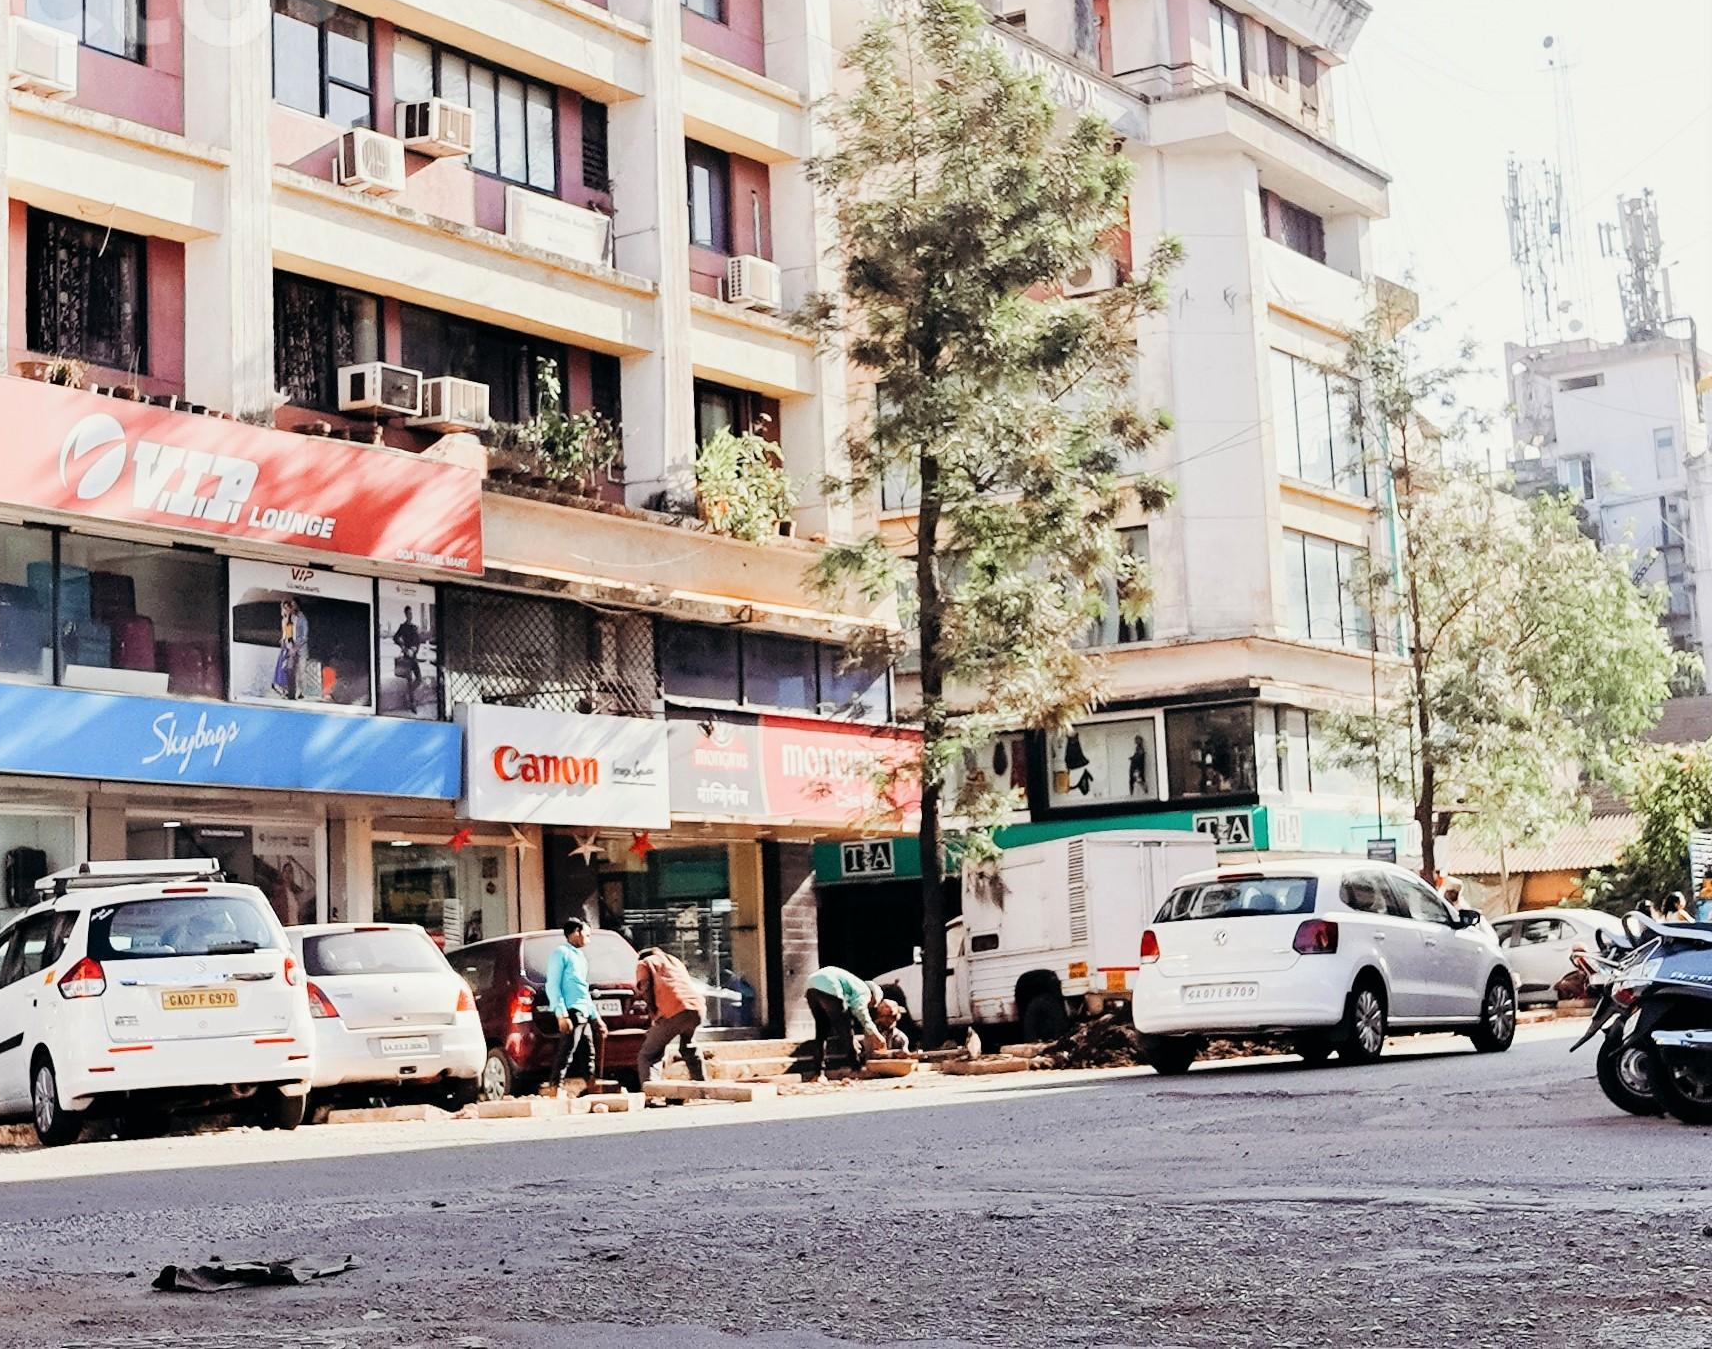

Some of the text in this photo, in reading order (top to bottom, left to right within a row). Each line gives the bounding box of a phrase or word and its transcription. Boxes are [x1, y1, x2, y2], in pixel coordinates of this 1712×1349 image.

[133, 441, 337, 540] VIP LOUNGE
[291, 567, 314, 582] VIP
[446, 556, 469, 568] MART
[141, 711, 240, 775] Skybags
[493, 745, 600, 786] Canon
[199, 994, 205, 1006] F
[209, 993, 236, 1005] 6970
